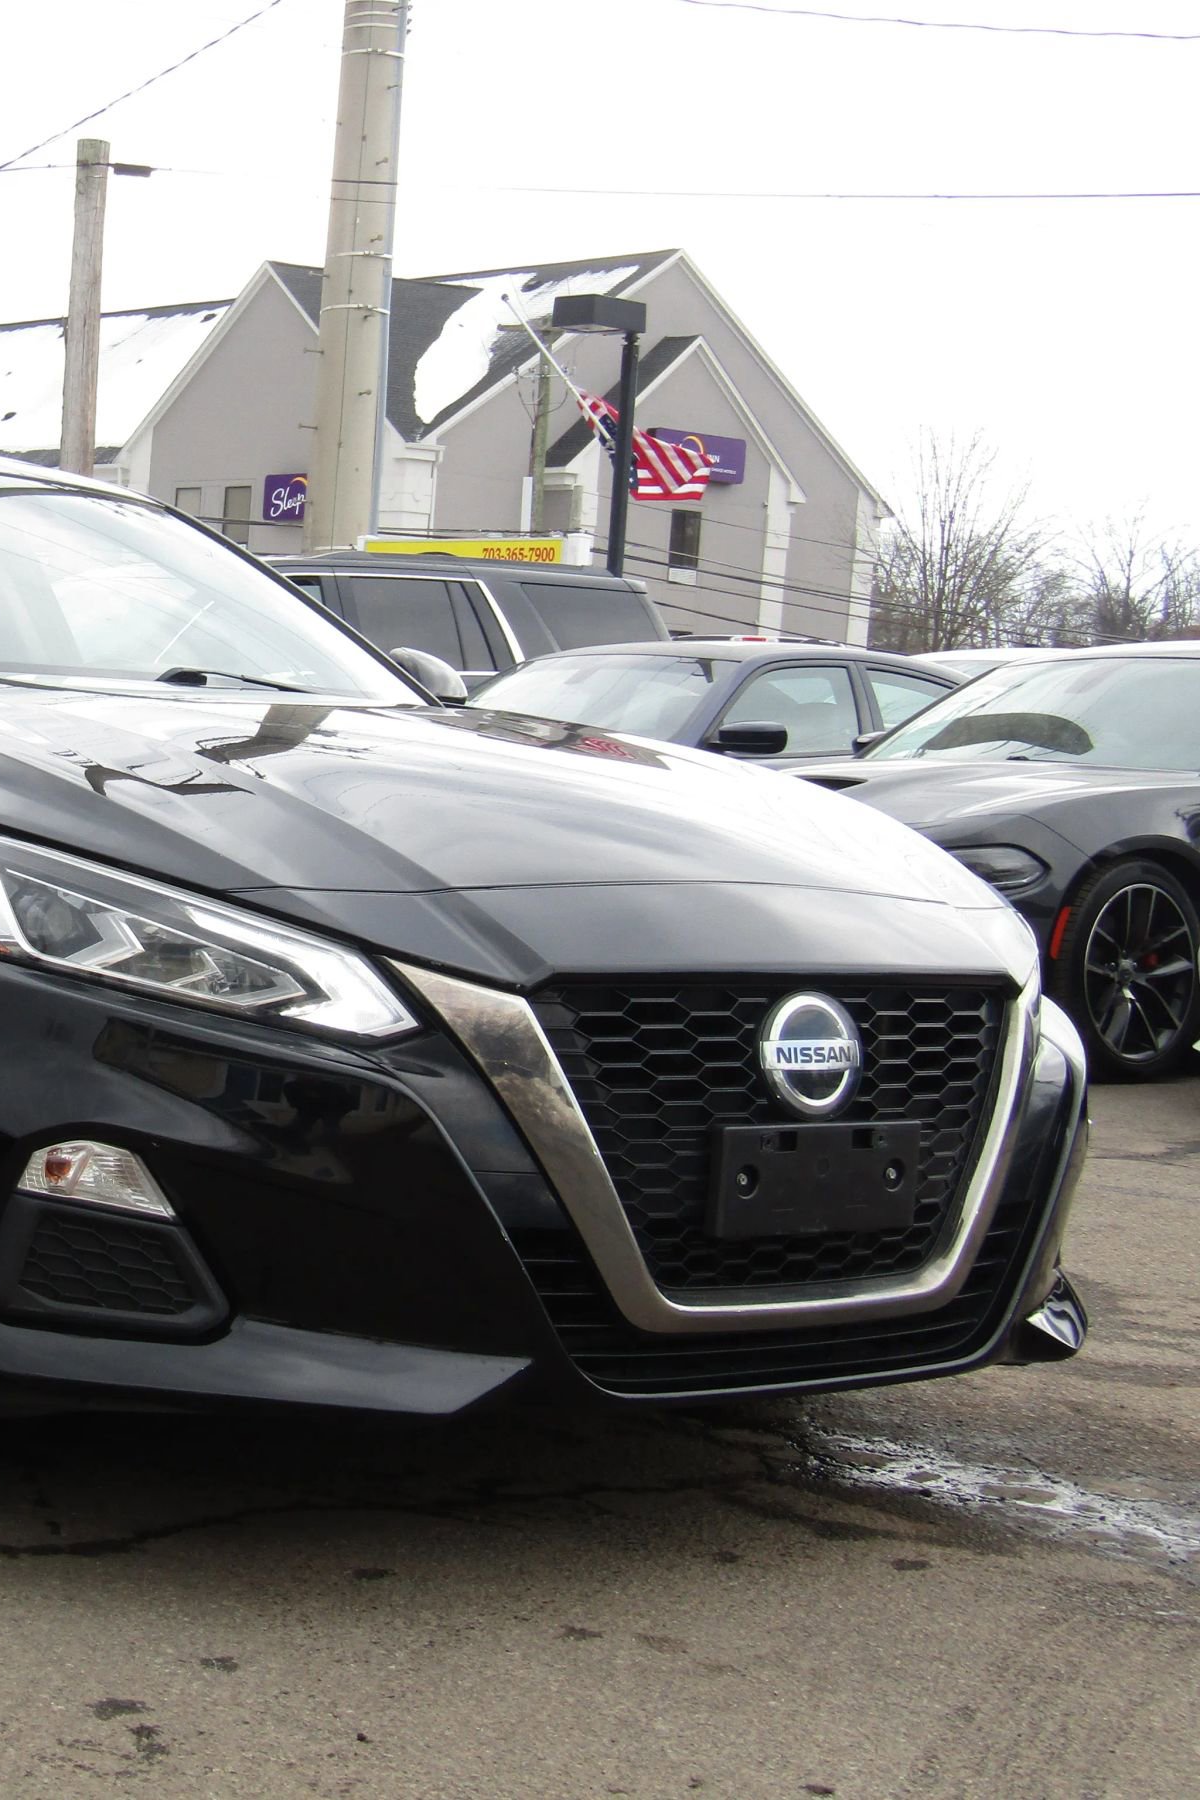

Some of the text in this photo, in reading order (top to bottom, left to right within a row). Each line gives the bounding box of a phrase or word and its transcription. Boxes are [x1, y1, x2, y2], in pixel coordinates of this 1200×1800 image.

[270, 486, 307, 518] Sleep
[482, 547, 556, 562] 703-365-7900
[775, 1045, 852, 1064] NISSAN
